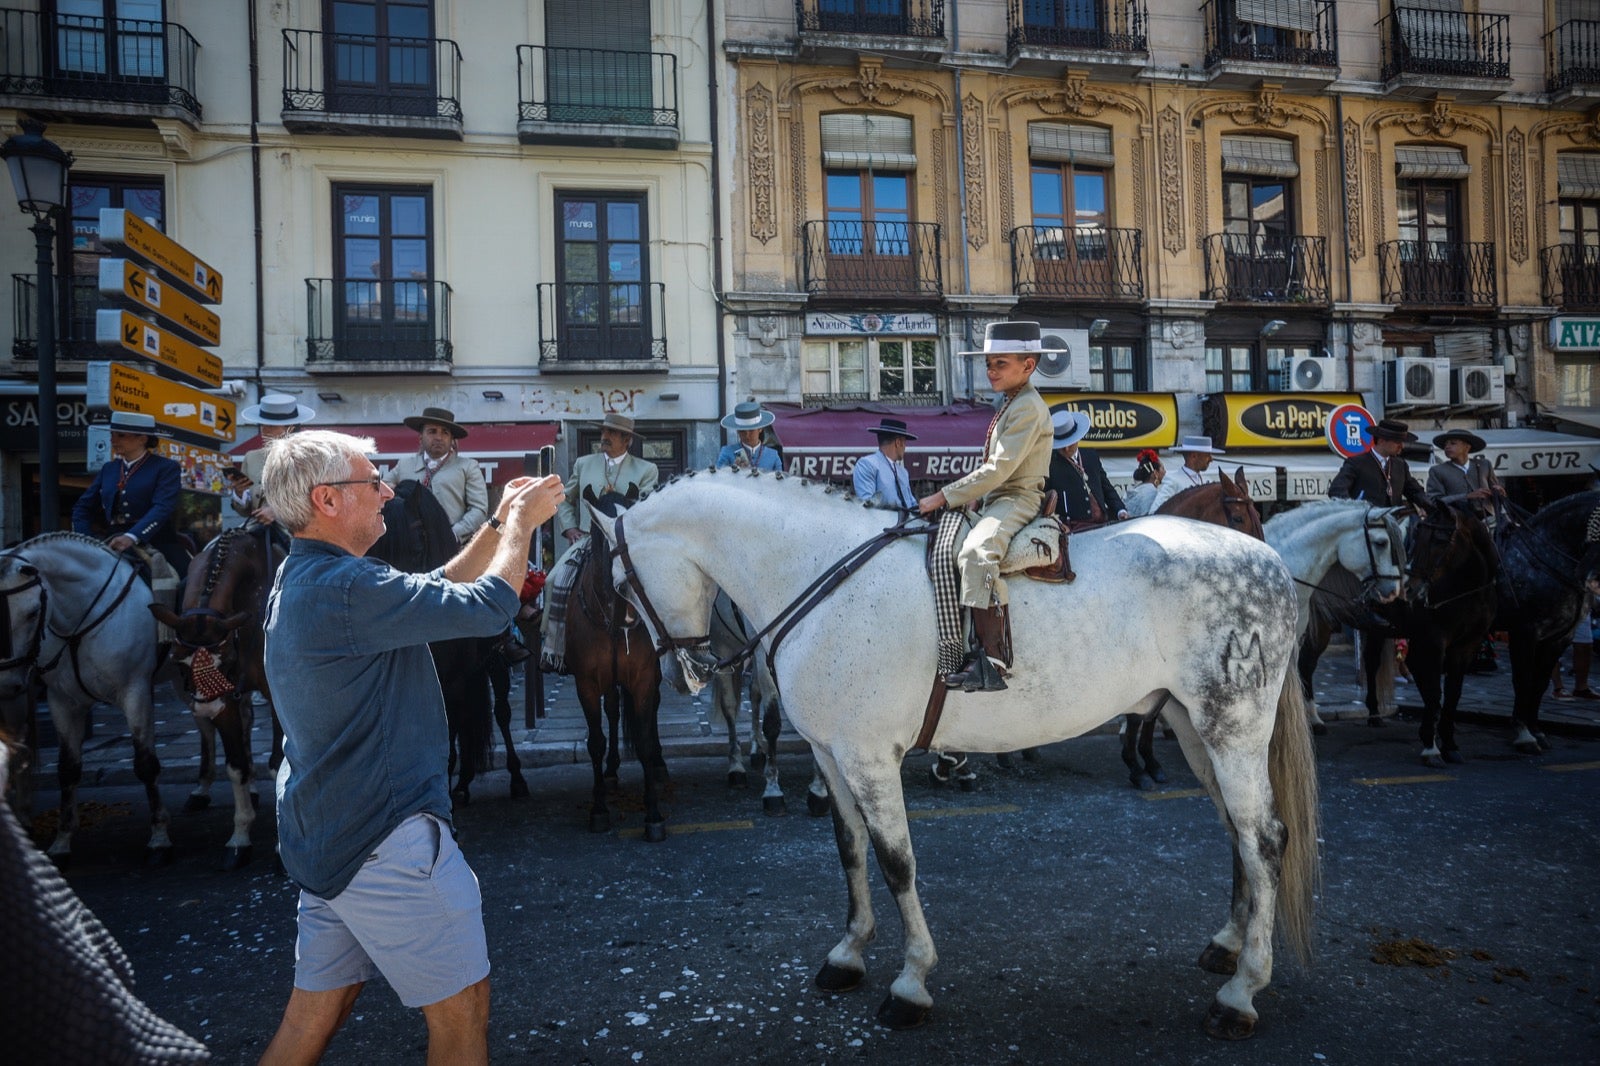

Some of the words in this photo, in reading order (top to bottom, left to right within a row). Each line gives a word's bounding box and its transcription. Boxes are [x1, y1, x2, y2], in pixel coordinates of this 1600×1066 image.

[115, 381, 150, 399] Austria
[114, 396, 141, 412] Viena
[1349, 426, 1358, 437] P
[1346, 438, 1362, 446] BUS
[1521, 451, 1581, 470] SUR
